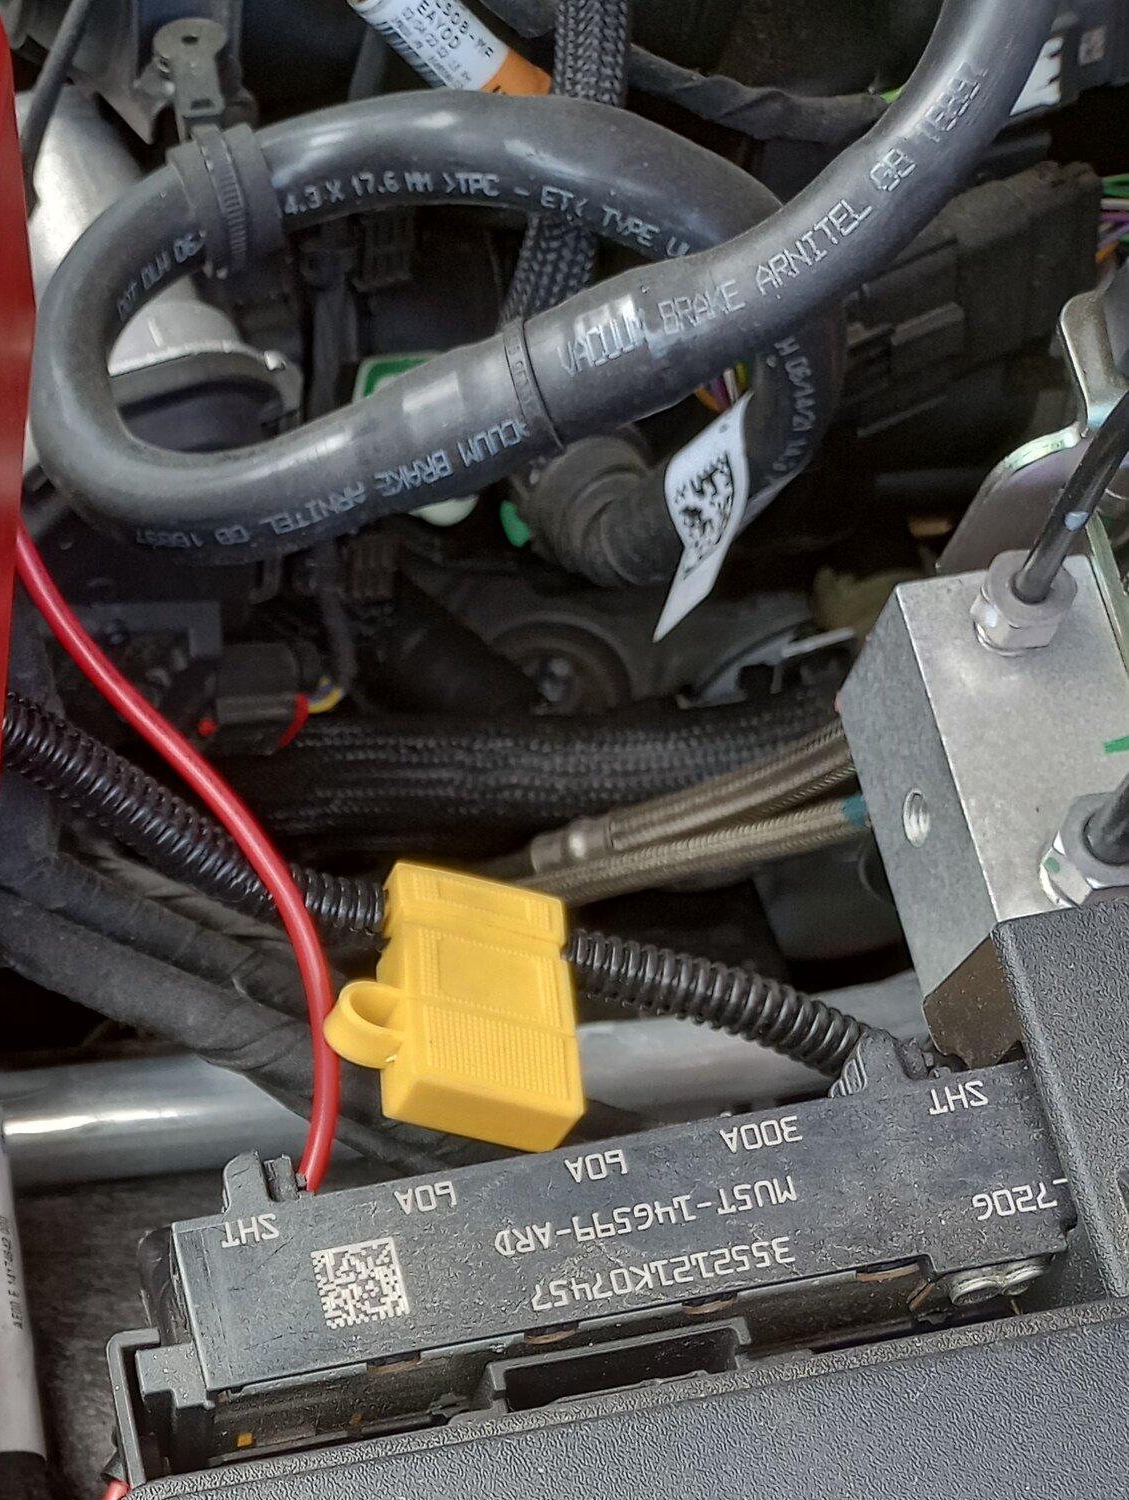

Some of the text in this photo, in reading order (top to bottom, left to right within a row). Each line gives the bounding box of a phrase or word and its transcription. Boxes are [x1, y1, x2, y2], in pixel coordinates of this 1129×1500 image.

[600, 204, 662, 248] TYPE
[658, 281, 746, 336] BRAKE
[754, 198, 872, 294] ARNITEL
[458, 418, 530, 468] CUUM
[374, 449, 456, 498] BRAKE
[259, 482, 369, 537] ARNITEL
[928, 1079, 988, 1116] SHT
[222, 1115, 803, 1248] 300A 60A 60A SHT
[975, 1175, 1071, 1220] 720G
